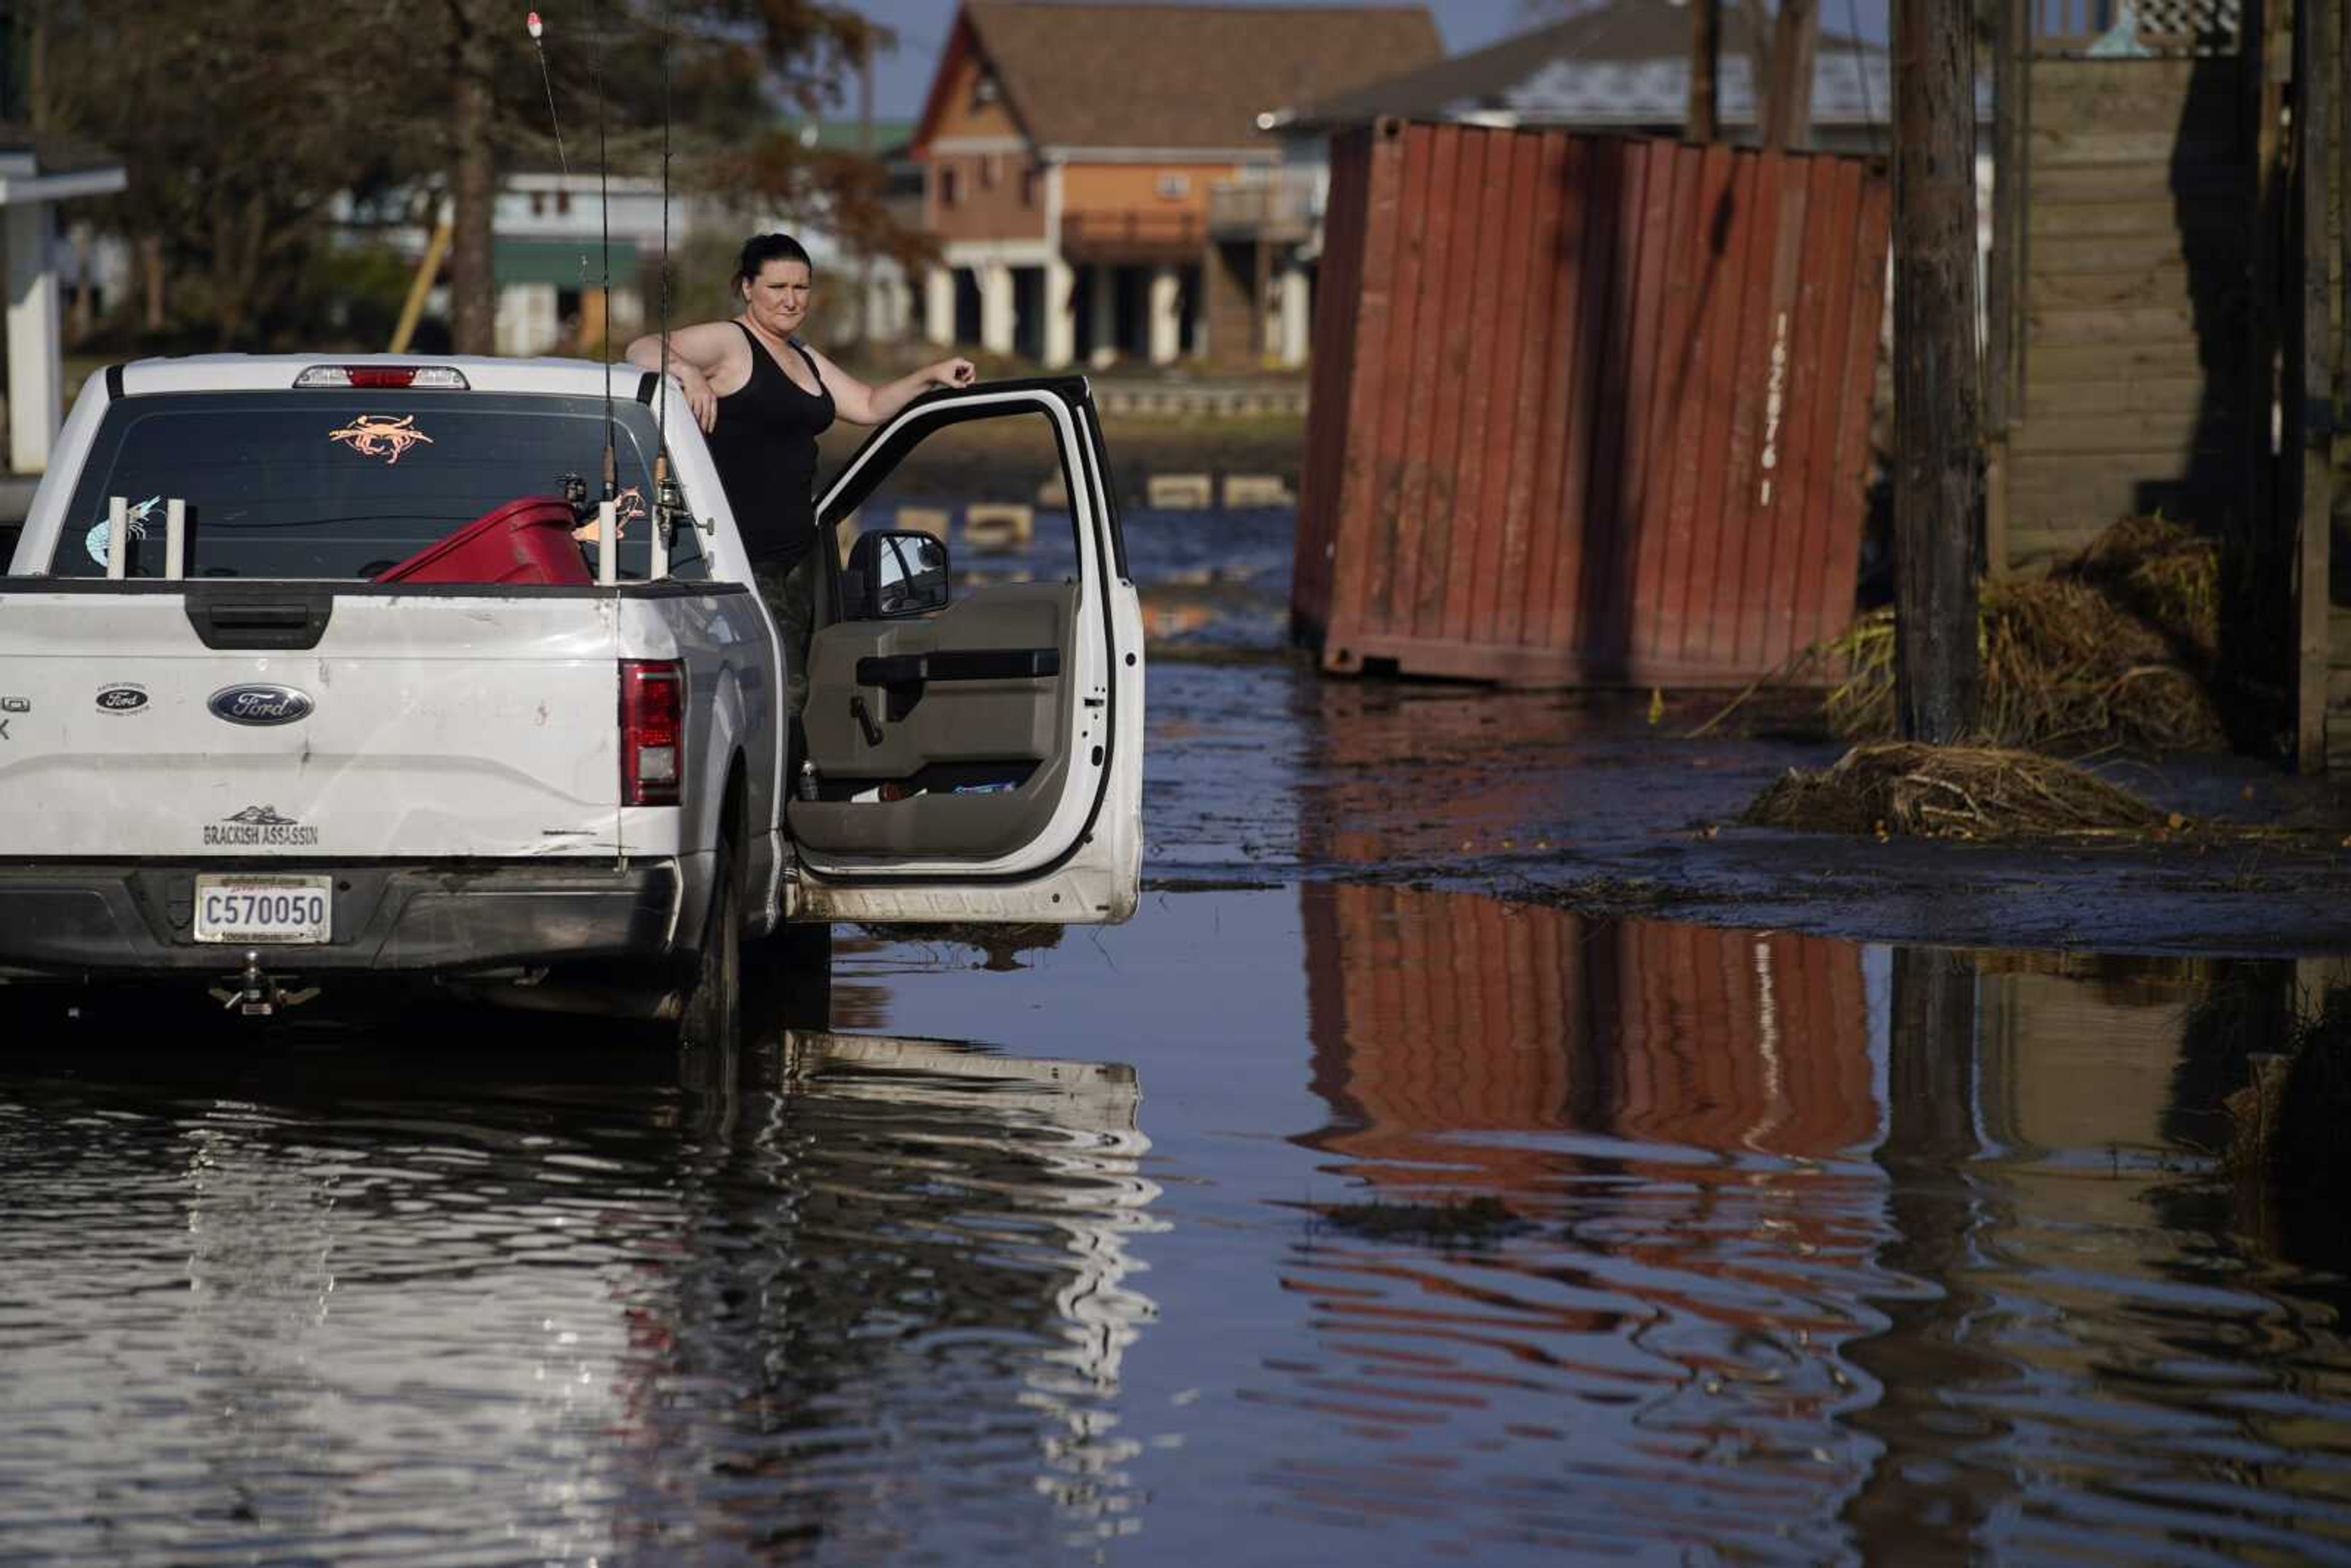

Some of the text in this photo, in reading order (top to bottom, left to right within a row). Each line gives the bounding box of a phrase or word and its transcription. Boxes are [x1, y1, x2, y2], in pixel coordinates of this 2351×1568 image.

[233, 692, 290, 718] Ford
[204, 825, 318, 845] BRACKISH ASSASSIN
[207, 896, 323, 925] C570050
